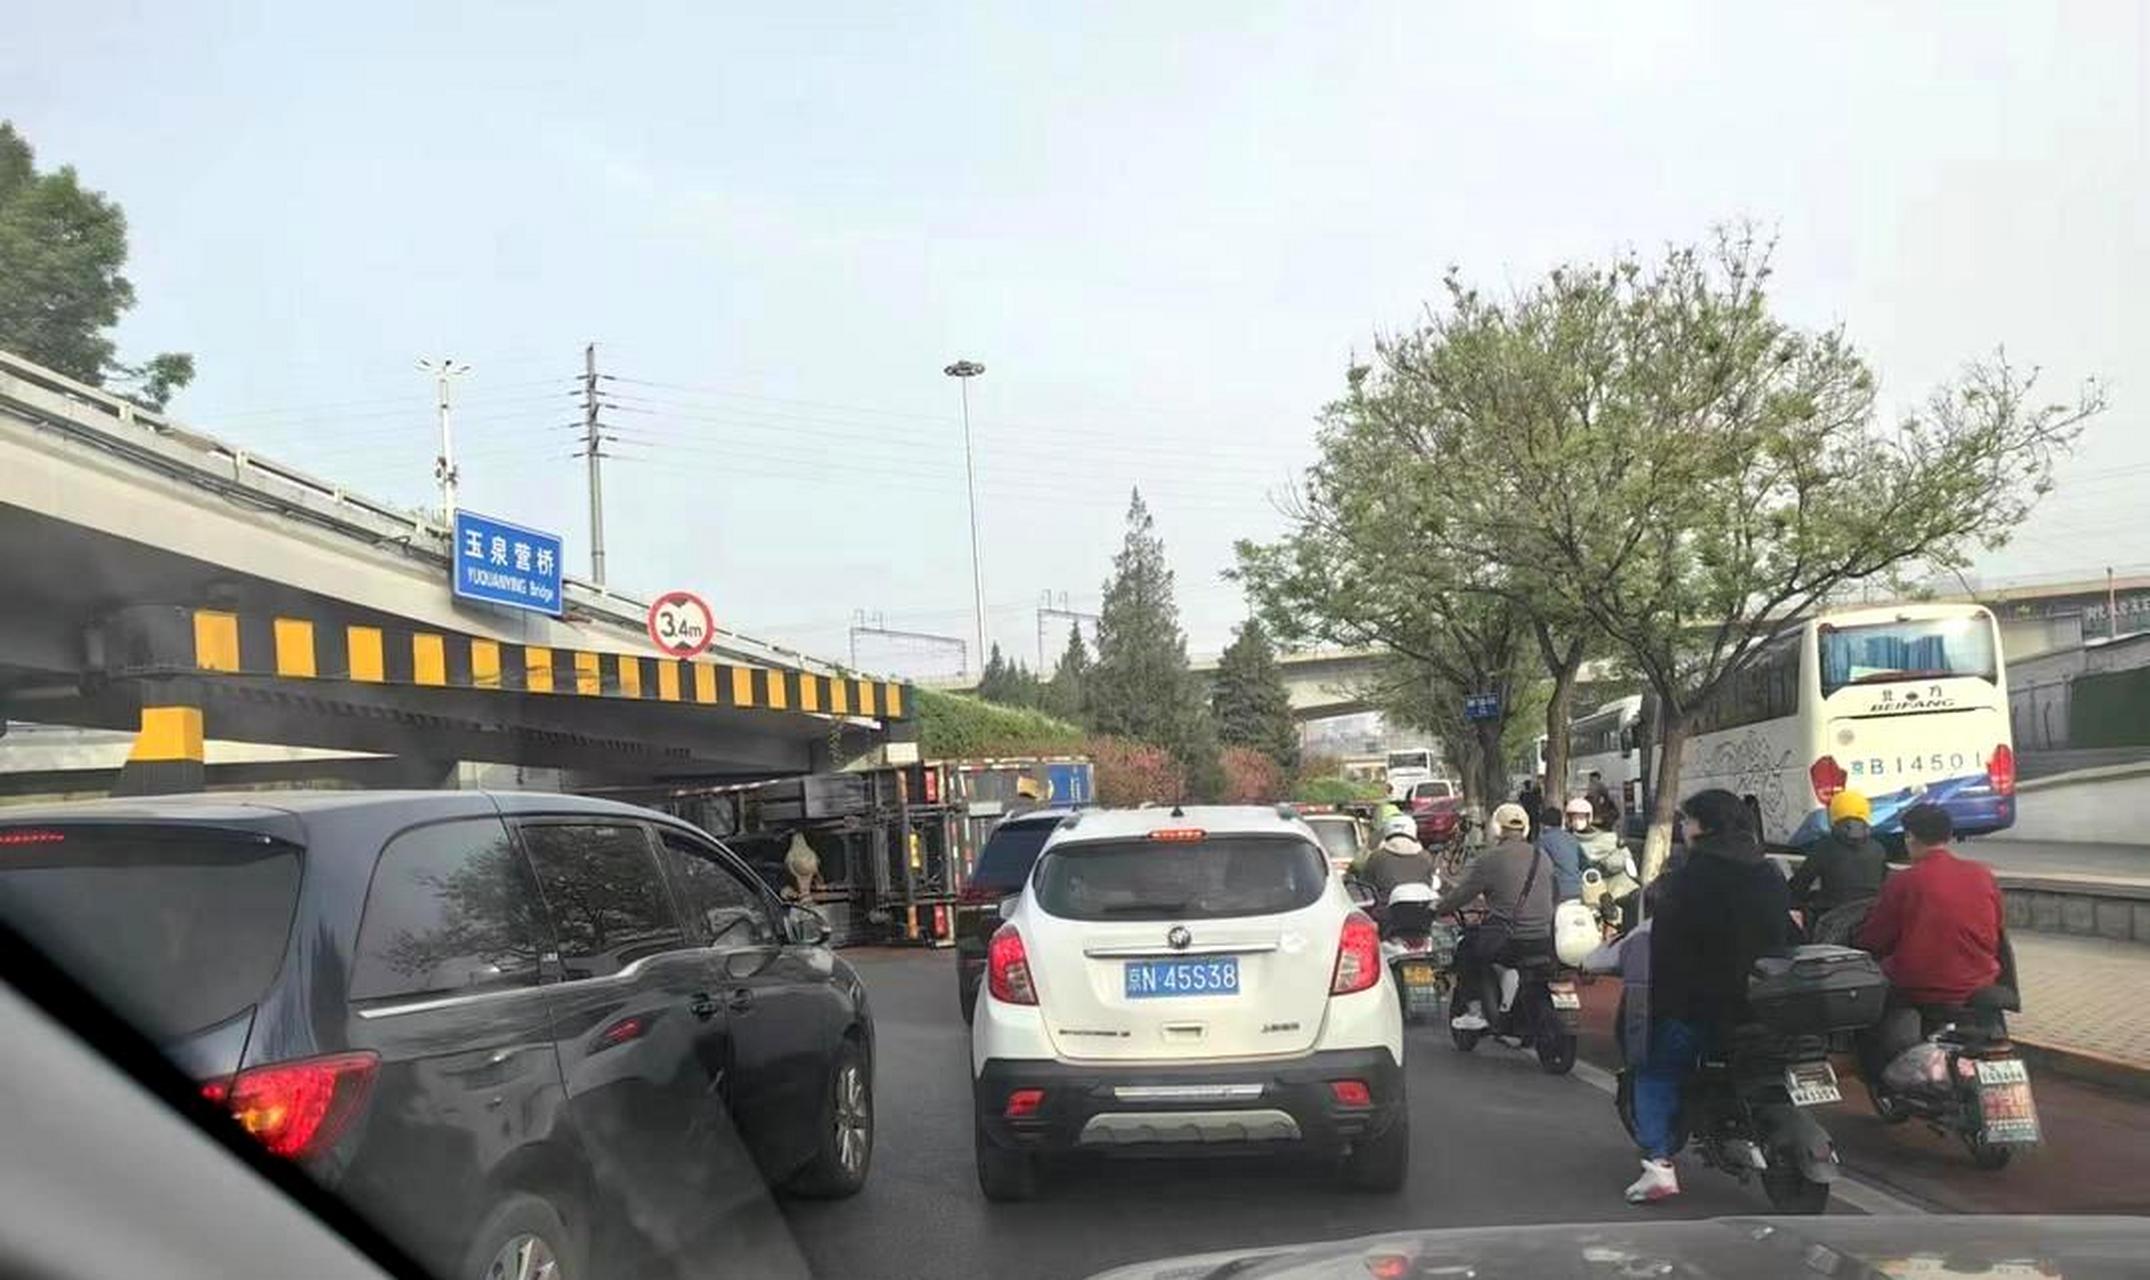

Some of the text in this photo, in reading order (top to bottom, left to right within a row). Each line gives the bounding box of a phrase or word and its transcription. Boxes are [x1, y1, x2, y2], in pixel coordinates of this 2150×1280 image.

[465, 529, 554, 577] 玉泉营桥
[660, 611, 703, 638] 3.4m
